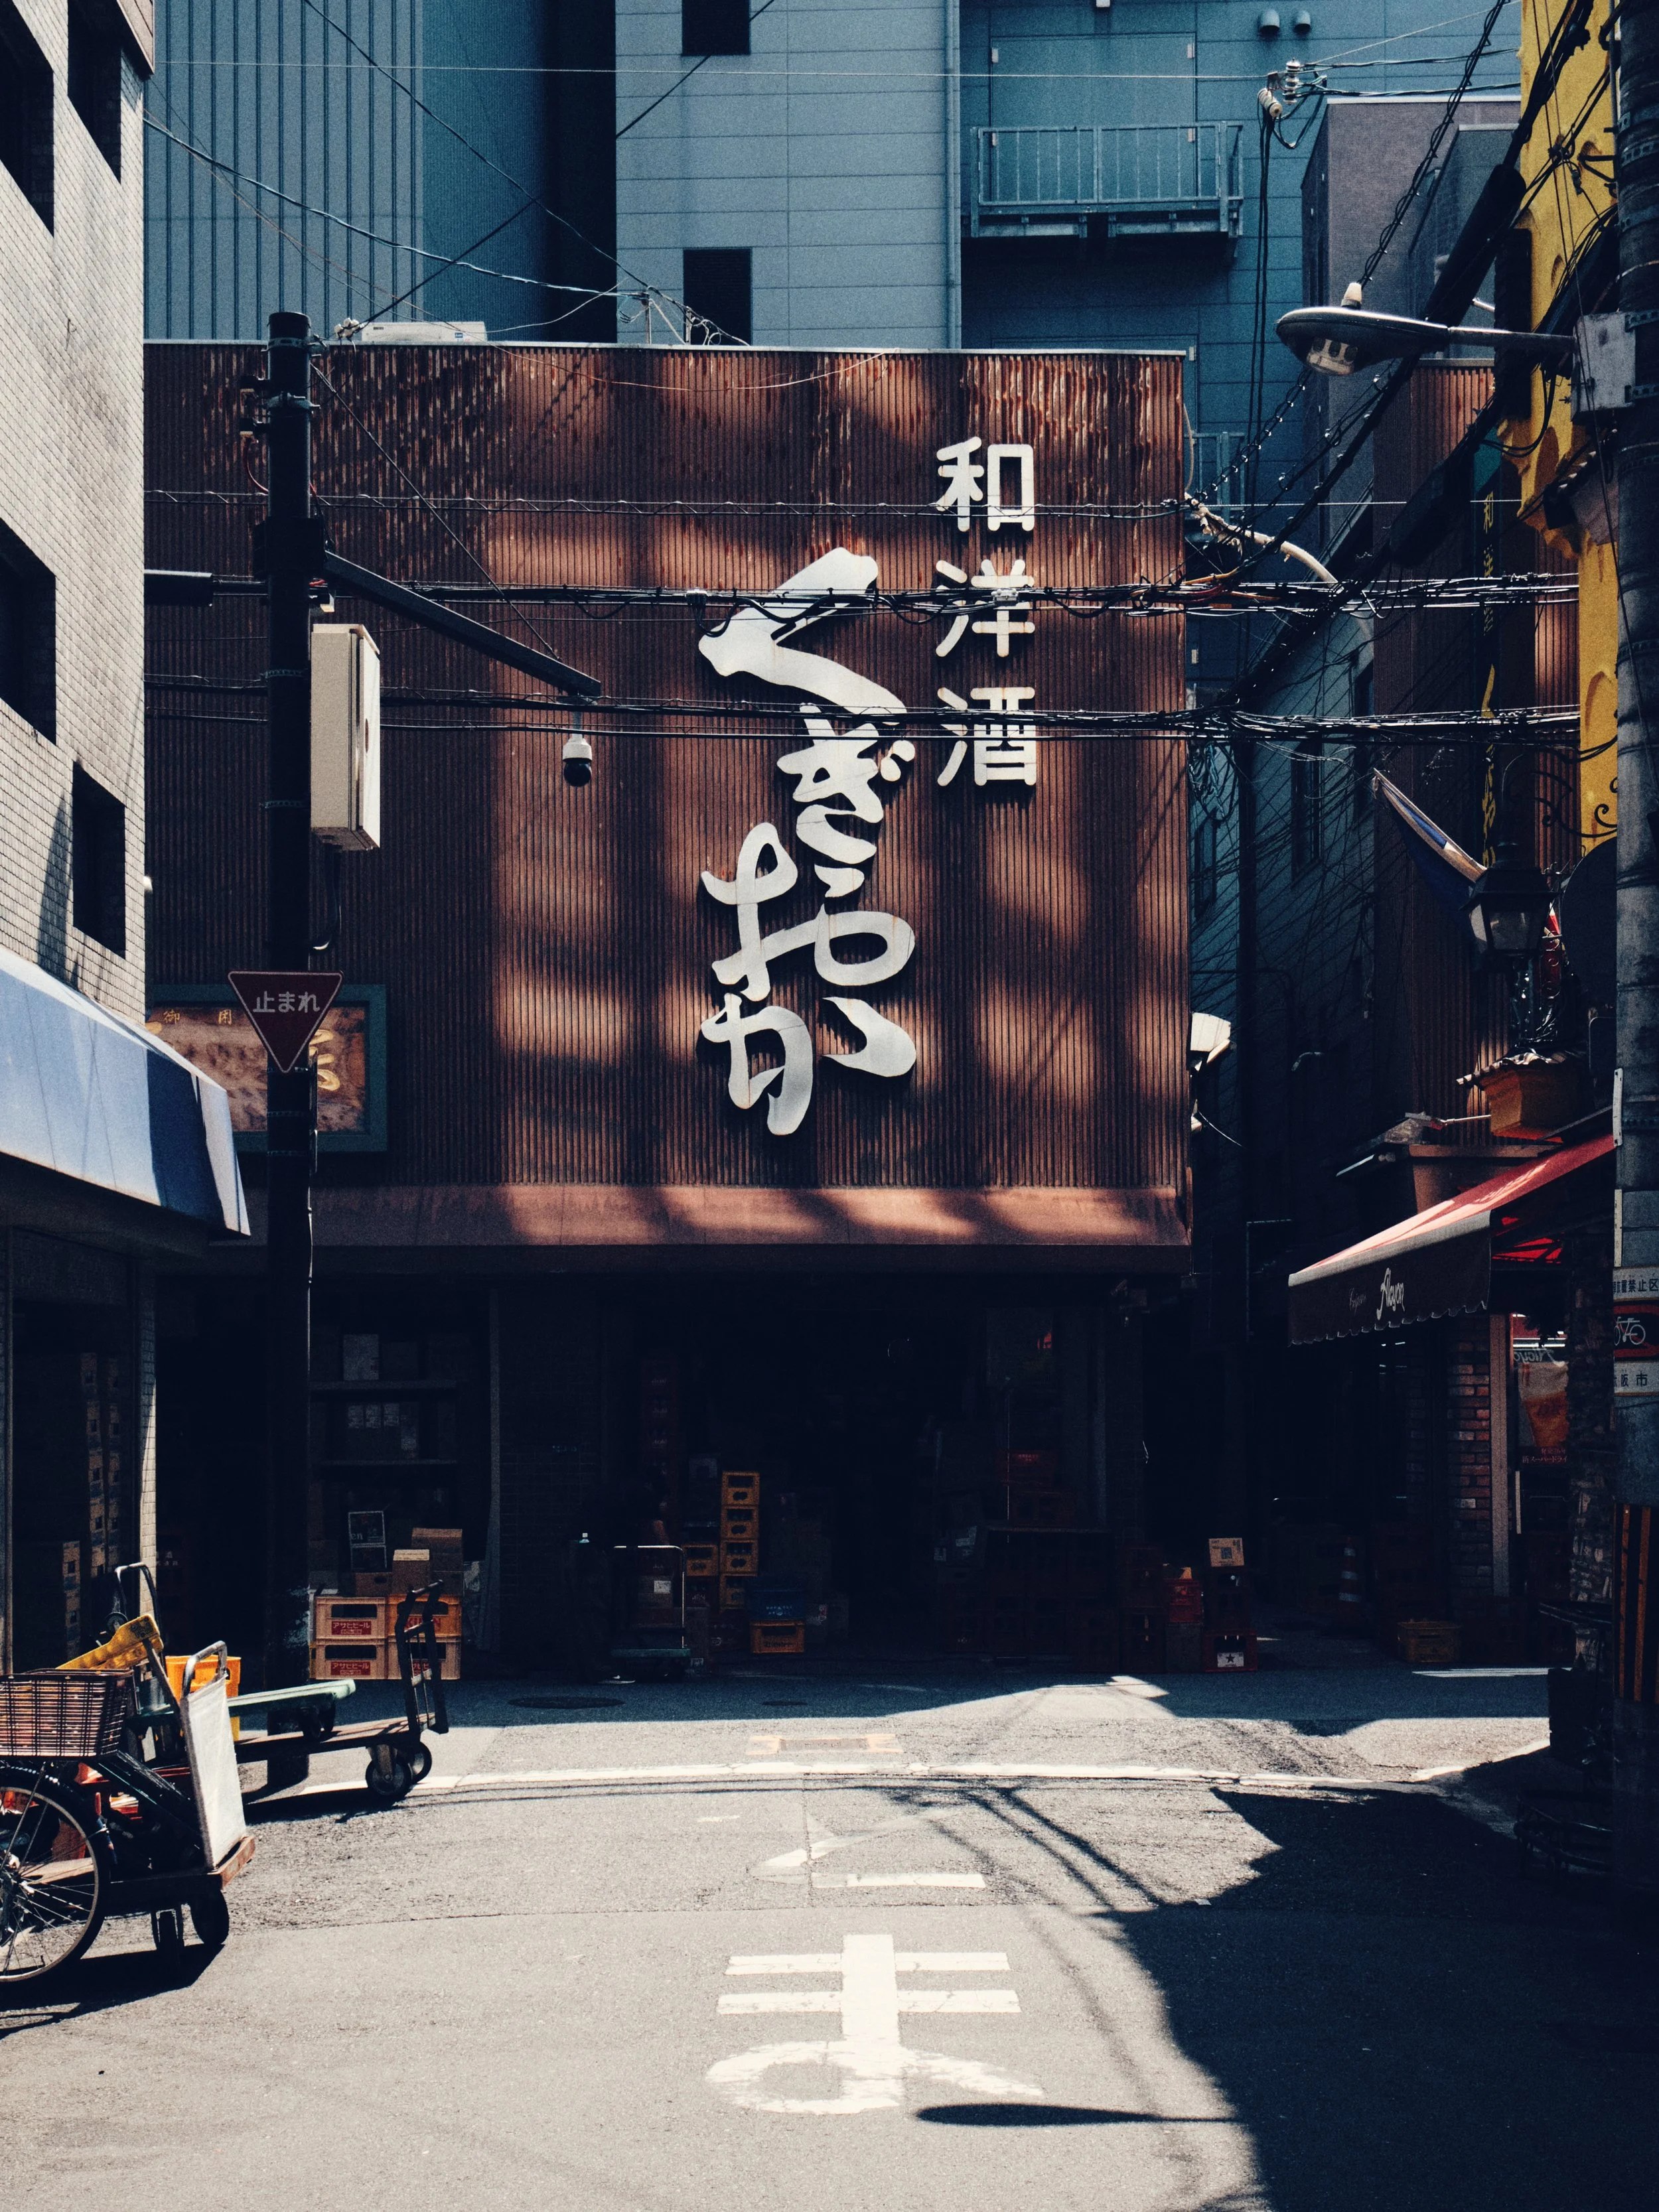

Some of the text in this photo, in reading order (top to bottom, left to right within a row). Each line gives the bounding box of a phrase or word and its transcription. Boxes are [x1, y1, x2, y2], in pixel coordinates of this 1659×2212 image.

[937, 435, 1037, 788] 和洋酒
[253, 991, 321, 1014] 止まれ
